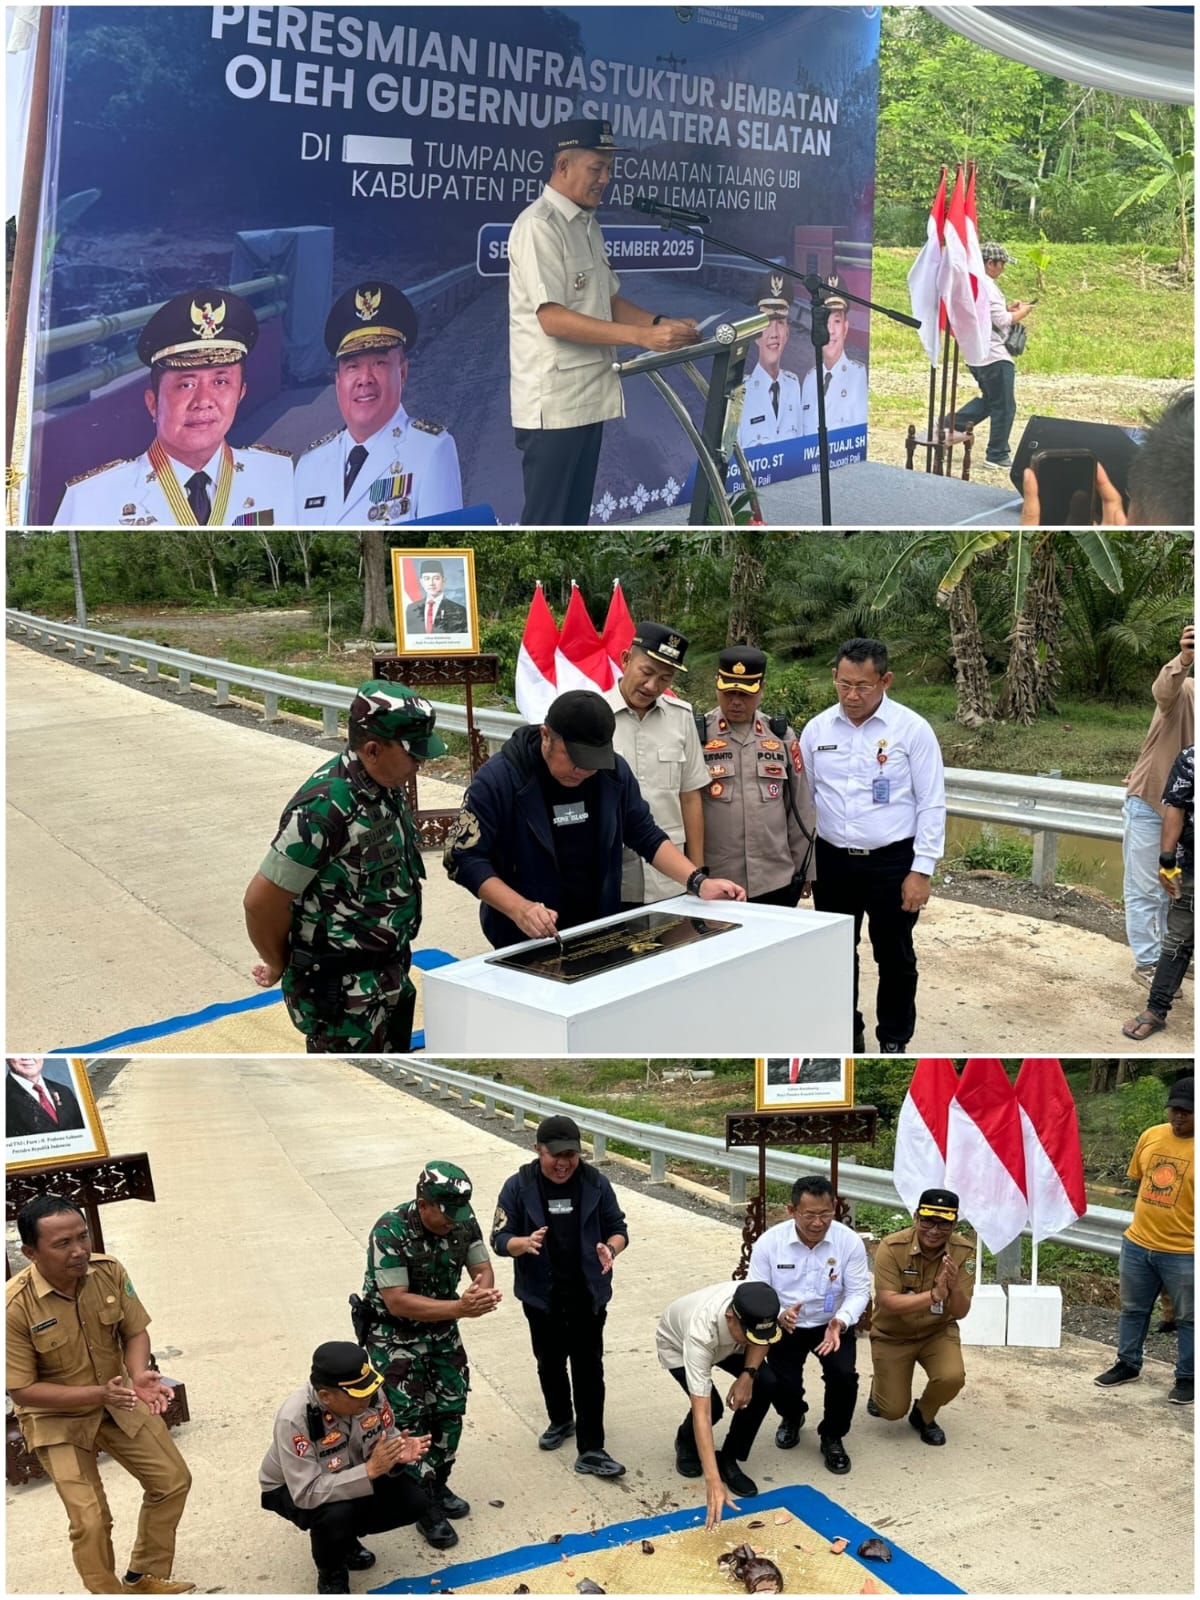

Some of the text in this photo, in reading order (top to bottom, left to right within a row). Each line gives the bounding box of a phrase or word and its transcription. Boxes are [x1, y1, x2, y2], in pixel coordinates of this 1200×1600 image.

[211, 6, 839, 125] PERESMIAN INFRASTUKTUR JEMBATAN
[225, 54, 831, 157] OLEH GUBERNUR SUMATERA SELATAN
[301, 132, 801, 189] DI TUMPANG ECAMATAN TALANG UBI
[351, 169, 504, 202] KABUPATEN
[664, 187, 750, 210] LEMATANG
[753, 192, 777, 211] ILIR
[662, 240, 694, 256] 2025
[855, 435, 866, 448] SH
[772, 453, 784, 467] ST
[758, 752, 785, 761] POLRI
